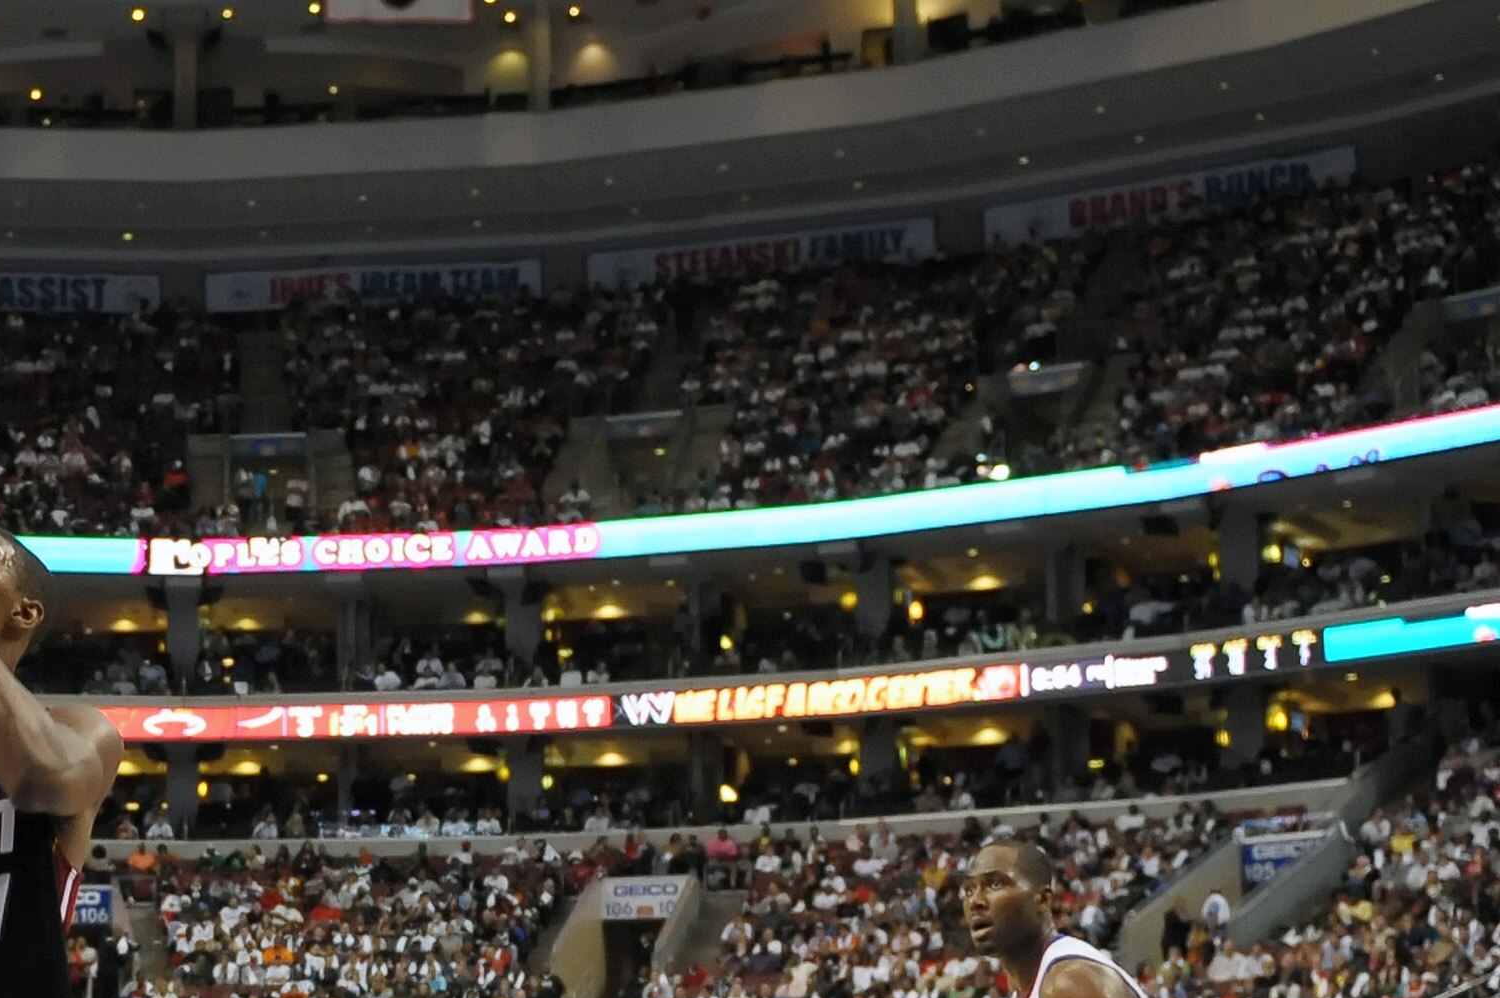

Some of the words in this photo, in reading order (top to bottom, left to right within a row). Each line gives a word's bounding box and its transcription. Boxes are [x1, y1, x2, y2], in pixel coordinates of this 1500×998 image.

[313, 533, 454, 566] CHOICE
[466, 526, 598, 561] AWARD
[614, 884, 678, 898] GEICO
